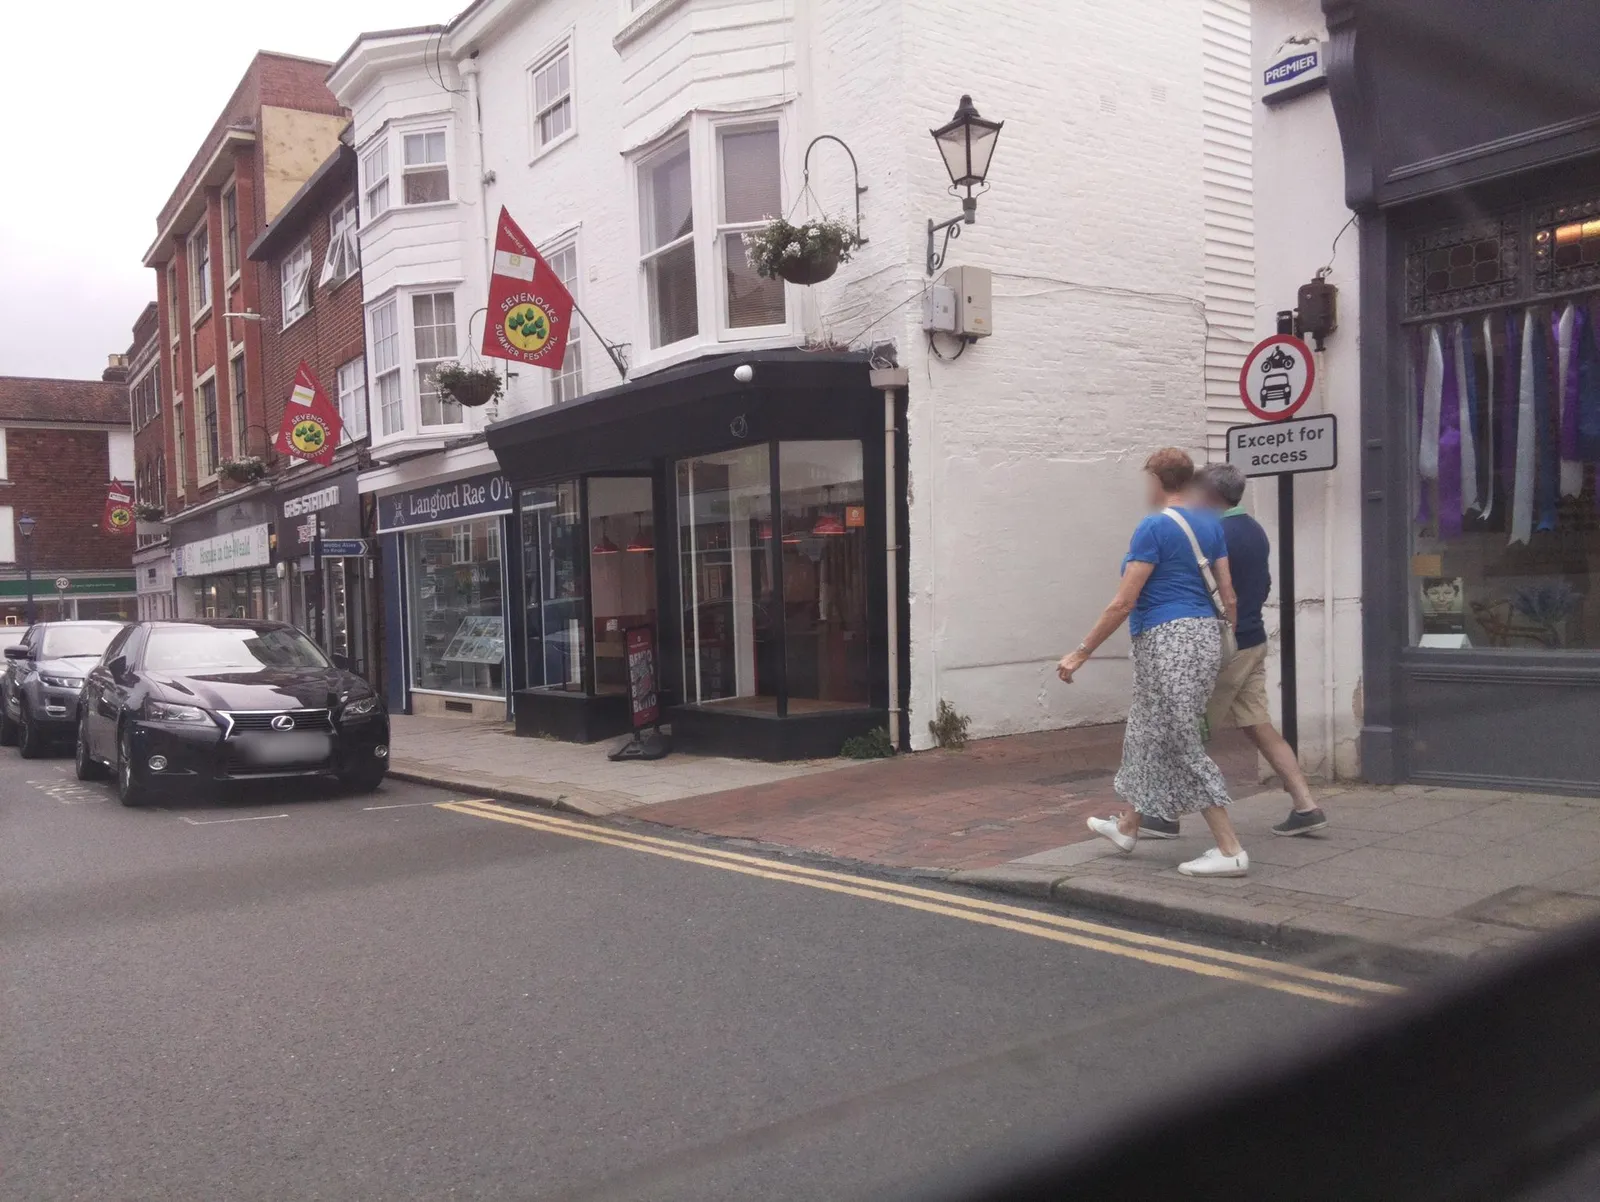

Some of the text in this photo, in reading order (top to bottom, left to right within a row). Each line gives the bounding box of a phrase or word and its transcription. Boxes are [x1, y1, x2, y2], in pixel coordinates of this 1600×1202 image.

[1265, 55, 1316, 83] PREMIER
[503, 226, 523, 251] supported
[501, 292, 559, 324] SEVENOAKS
[495, 323, 558, 361] SUMMER FESTIVAL
[291, 413, 331, 437] SEVENOAKS
[1237, 426, 1324, 449] Except for
[302, 443, 330, 459] FESTIVAL
[1251, 449, 1308, 467] access
[409, 484, 460, 519] Langford
[462, 483, 486, 506] Rae
[57, 579, 68, 587] 20
